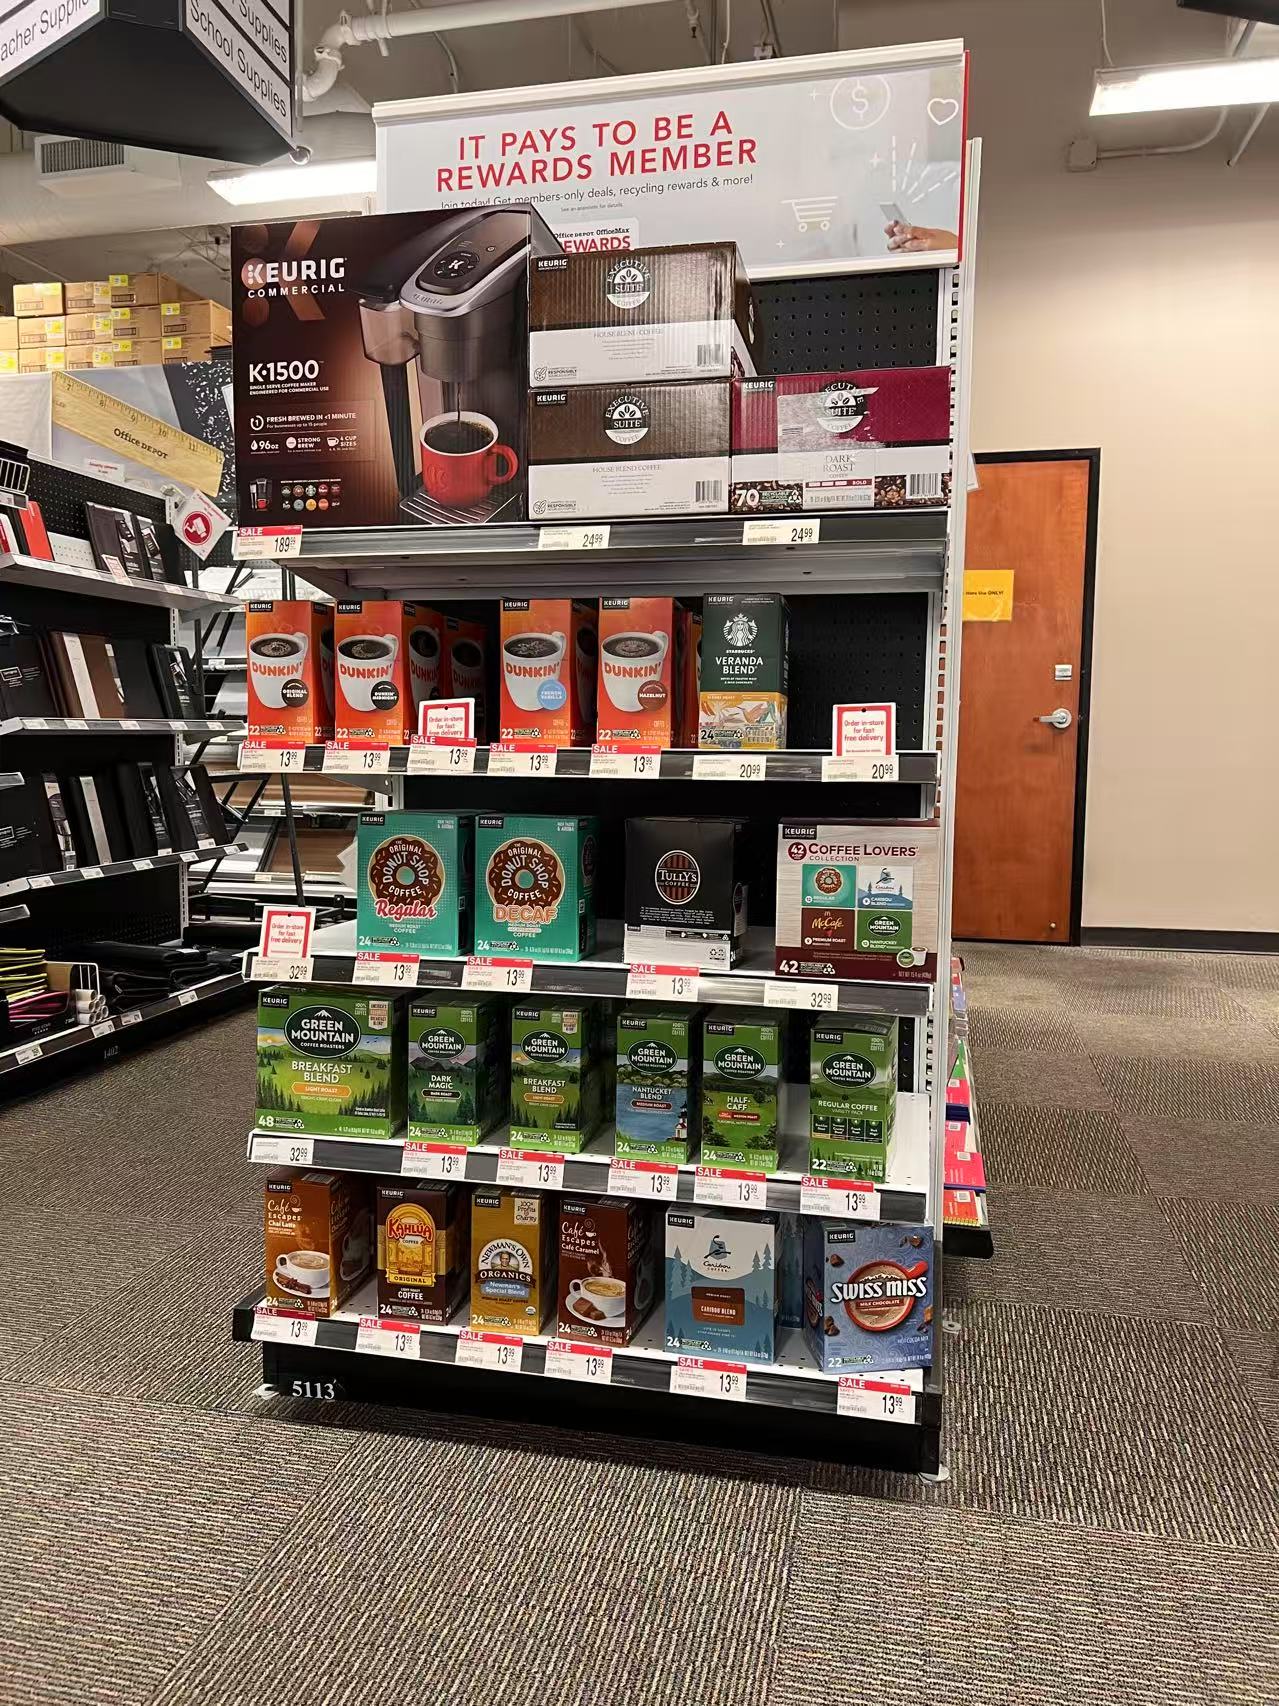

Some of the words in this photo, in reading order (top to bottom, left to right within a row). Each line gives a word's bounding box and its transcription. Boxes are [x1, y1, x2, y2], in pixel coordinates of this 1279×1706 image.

[191, 0, 233, 61] School
[237, 48, 287, 117] Supplies
[458, 135, 485, 161] IT
[501, 126, 576, 157] PAYS
[592, 120, 637, 148] TO
[654, 114, 693, 142] BE
[710, 110, 733, 136] A
[437, 154, 592, 192] REWARDS
[610, 139, 757, 177] MEMBER
[493, 196, 511, 206] Get
[512, 190, 585, 205] members-only
[588, 185, 616, 199] deals,
[619, 181, 664, 197] recycling
[667, 177, 709, 190] rewards
[711, 177, 720, 187] &
[723, 174, 754, 186] more!
[596, 227, 630, 236] OfficeMax
[538, 259, 567, 267] KEURIG
[248, 258, 345, 284] KEURIG
[248, 284, 345, 298] COMMERCIAL
[66, 384, 73, 392] 7
[537, 394, 567, 402] KEURIG
[605, 396, 650, 418] EXECUTIVE
[130, 414, 137, 423] 9
[613, 420, 641, 429] SUITE
[158, 427, 167, 438] 10
[114, 428, 141, 447] Office
[141, 443, 168, 460] DEPOT
[259, 440, 279, 449] 96oz
[735, 489, 760, 507] 70
[715, 657, 763, 665] VERANDA
[251, 661, 302, 676] DUNKIN'
[340, 664, 393, 679] DUNKIN'
[505, 663, 559, 678] DUNKIN'
[605, 661, 661, 678] DUNKIN'
[723, 666, 755, 674] BLEND
[244, 741, 266, 749] SALE
[412, 736, 436, 744] SALE
[326, 742, 349, 750] SALE
[491, 744, 515, 752] SALE
[594, 745, 618, 753] SALE
[389, 844, 422, 854] ORIGINAL
[507, 847, 541, 858] ORIGINAL
[791, 845, 804, 853] 42
[809, 843, 861, 855] COFFEE
[864, 844, 916, 857] LOVERS
[383, 851, 408, 884] DONUT
[410, 855, 430, 886] SHOP
[658, 869, 697, 882] TULLY'S
[388, 885, 423, 897] COFFEE
[507, 889, 542, 900] COFFEE
[376, 898, 437, 920] Regular
[494, 905, 557, 923] DECAF
[469, 957, 493, 965] SALE
[631, 965, 656, 973] SALE
[779, 961, 798, 973] 42
[301, 1019, 343, 1031] GREEN
[292, 1030, 354, 1043] MOUNTAIN
[422, 1042, 462, 1050] MOUNTAIN
[525, 1045, 565, 1053] MOUNTAIN
[637, 1048, 665, 1056] GREEN
[631, 1055, 673, 1064] MOUNTAIN
[725, 1053, 754, 1062] GREEN
[292, 1061, 352, 1074] BREAKFAST
[718, 1061, 762, 1070] MOUNTAIN
[832, 1062, 863, 1070] GREEN
[304, 1073, 339, 1083] BLEND
[825, 1068, 871, 1078] MOUNTAIN
[523, 1078, 565, 1086] BREAKFAST
[532, 1085, 557, 1093] BLEND
[632, 1086, 671, 1094] NANTUCKET
[818, 1100, 850, 1109] REGULAR
[851, 1103, 878, 1111] COFFEE
[258, 1116, 275, 1127] 48
[405, 1143, 427, 1151] SALE
[500, 1151, 523, 1159] SALE
[612, 1160, 635, 1169] SALE
[698, 1168, 722, 1177] SALE
[802, 1177, 828, 1187] SALE
[267, 1199, 290, 1214] Café
[268, 1213, 301, 1221] Escapes
[388, 1218, 432, 1239] KAHLÚA
[561, 1221, 584, 1239] Café
[561, 1235, 595, 1246] Escapes
[561, 1243, 575, 1251] Café
[575, 1245, 600, 1255] Caramel
[481, 1241, 517, 1265] NEWMAN'S
[516, 1249, 530, 1269] OWN
[703, 1259, 731, 1268] Caribou
[394, 1276, 427, 1284] ORIGINAL
[480, 1270, 531, 1282] ORGANICS
[830, 1281, 882, 1303] SWISS
[886, 1276, 928, 1298] MISS
[397, 1291, 424, 1300] COFFEE
[256, 1308, 277, 1316] SALE
[700, 1305, 720, 1313] CARIBOU
[721, 1307, 736, 1315] BLEND
[360, 1319, 382, 1328] SALE
[460, 1331, 483, 1340] SALE
[548, 1342, 572, 1352] SALE
[679, 1357, 704, 1368] SALE
[839, 1378, 865, 1388] SALE
[292, 1381, 335, 1399] 5113
